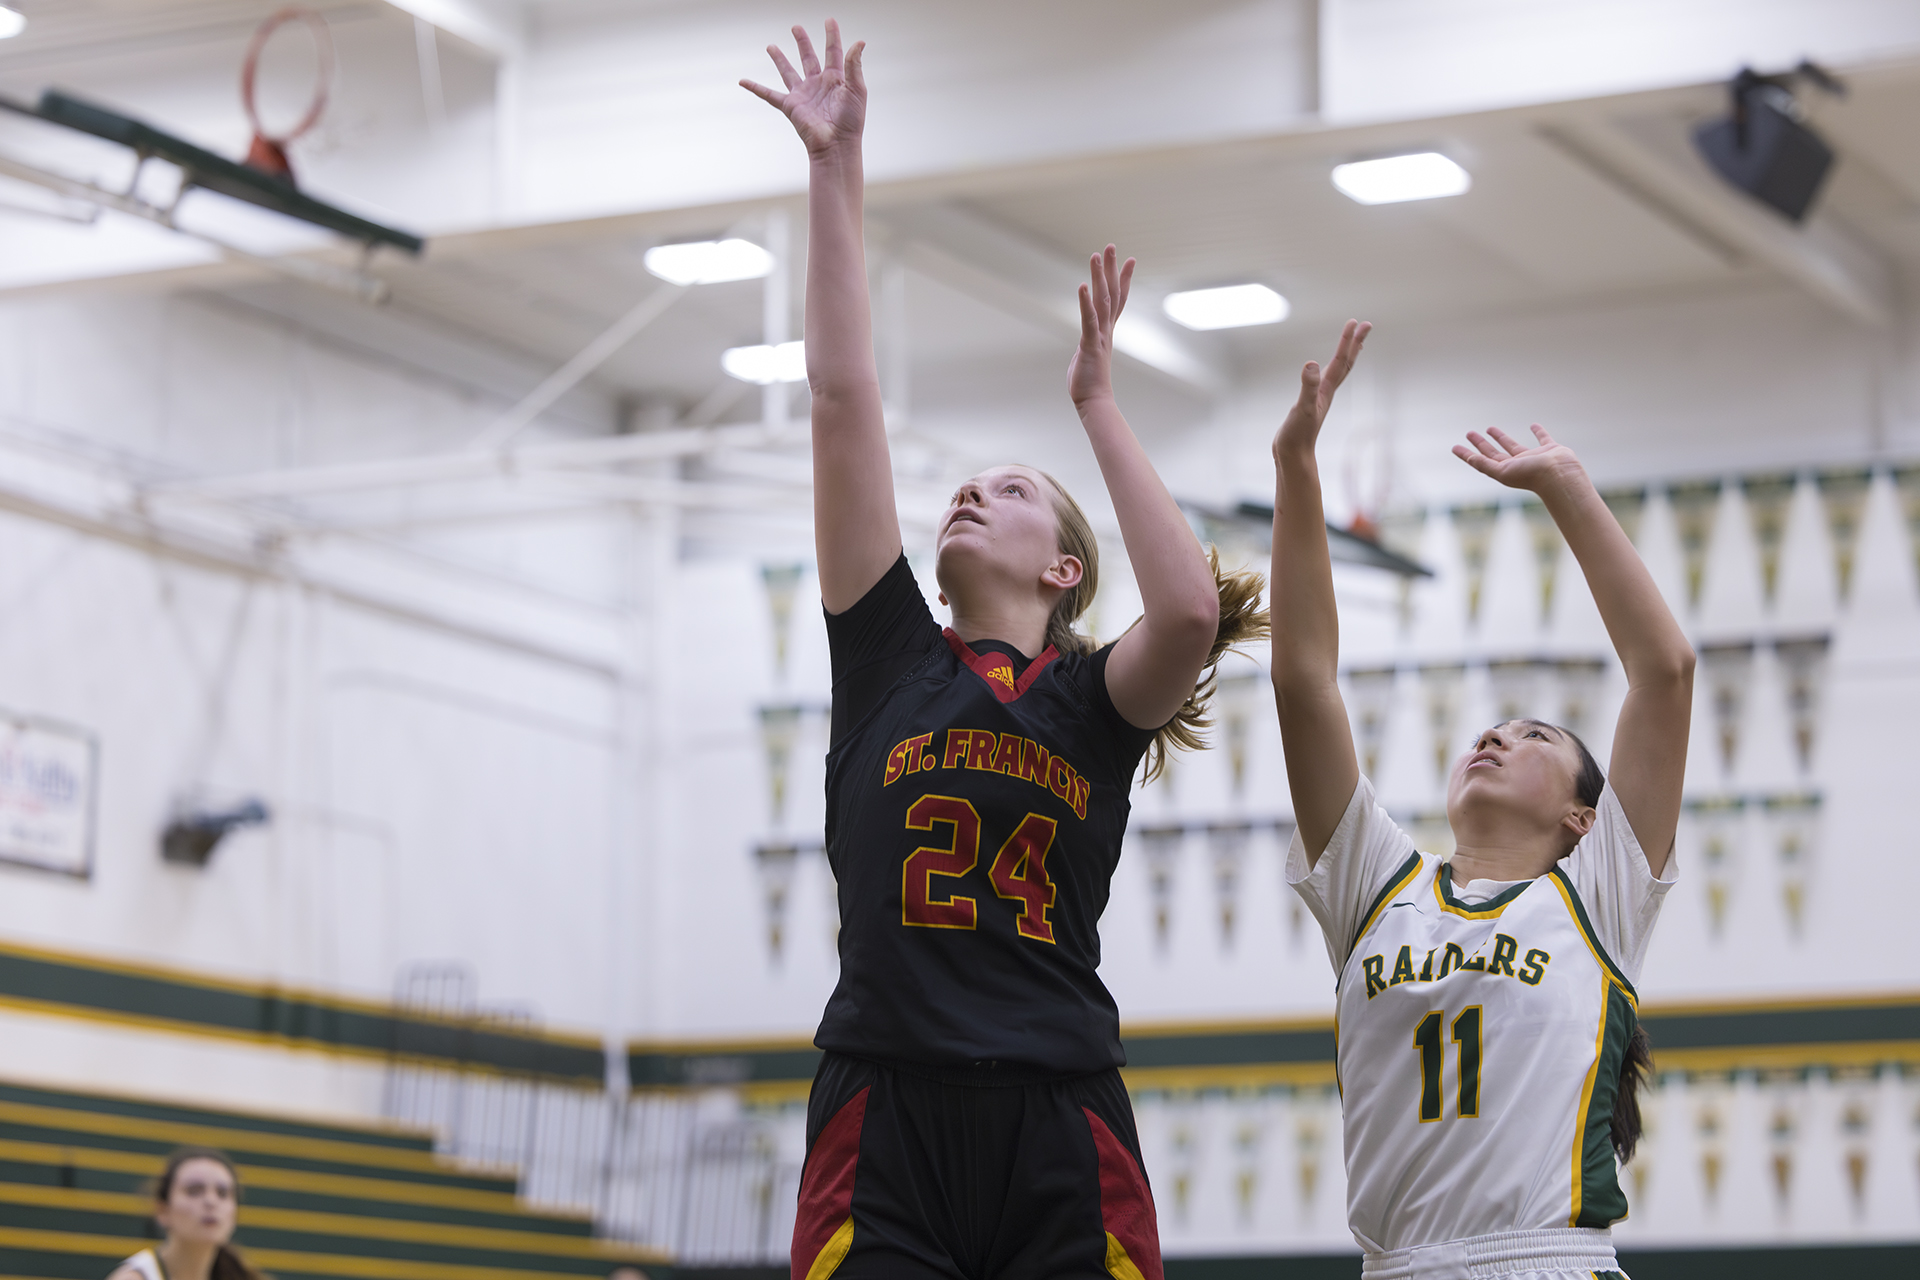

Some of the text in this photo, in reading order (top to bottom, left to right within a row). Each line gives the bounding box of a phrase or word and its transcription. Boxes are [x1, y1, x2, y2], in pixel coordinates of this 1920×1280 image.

[987, 671, 1014, 691] adida
[884, 728, 1090, 820] ST. FRANCIS
[902, 794, 1058, 945] 24
[1412, 1004, 1483, 1124] 11
